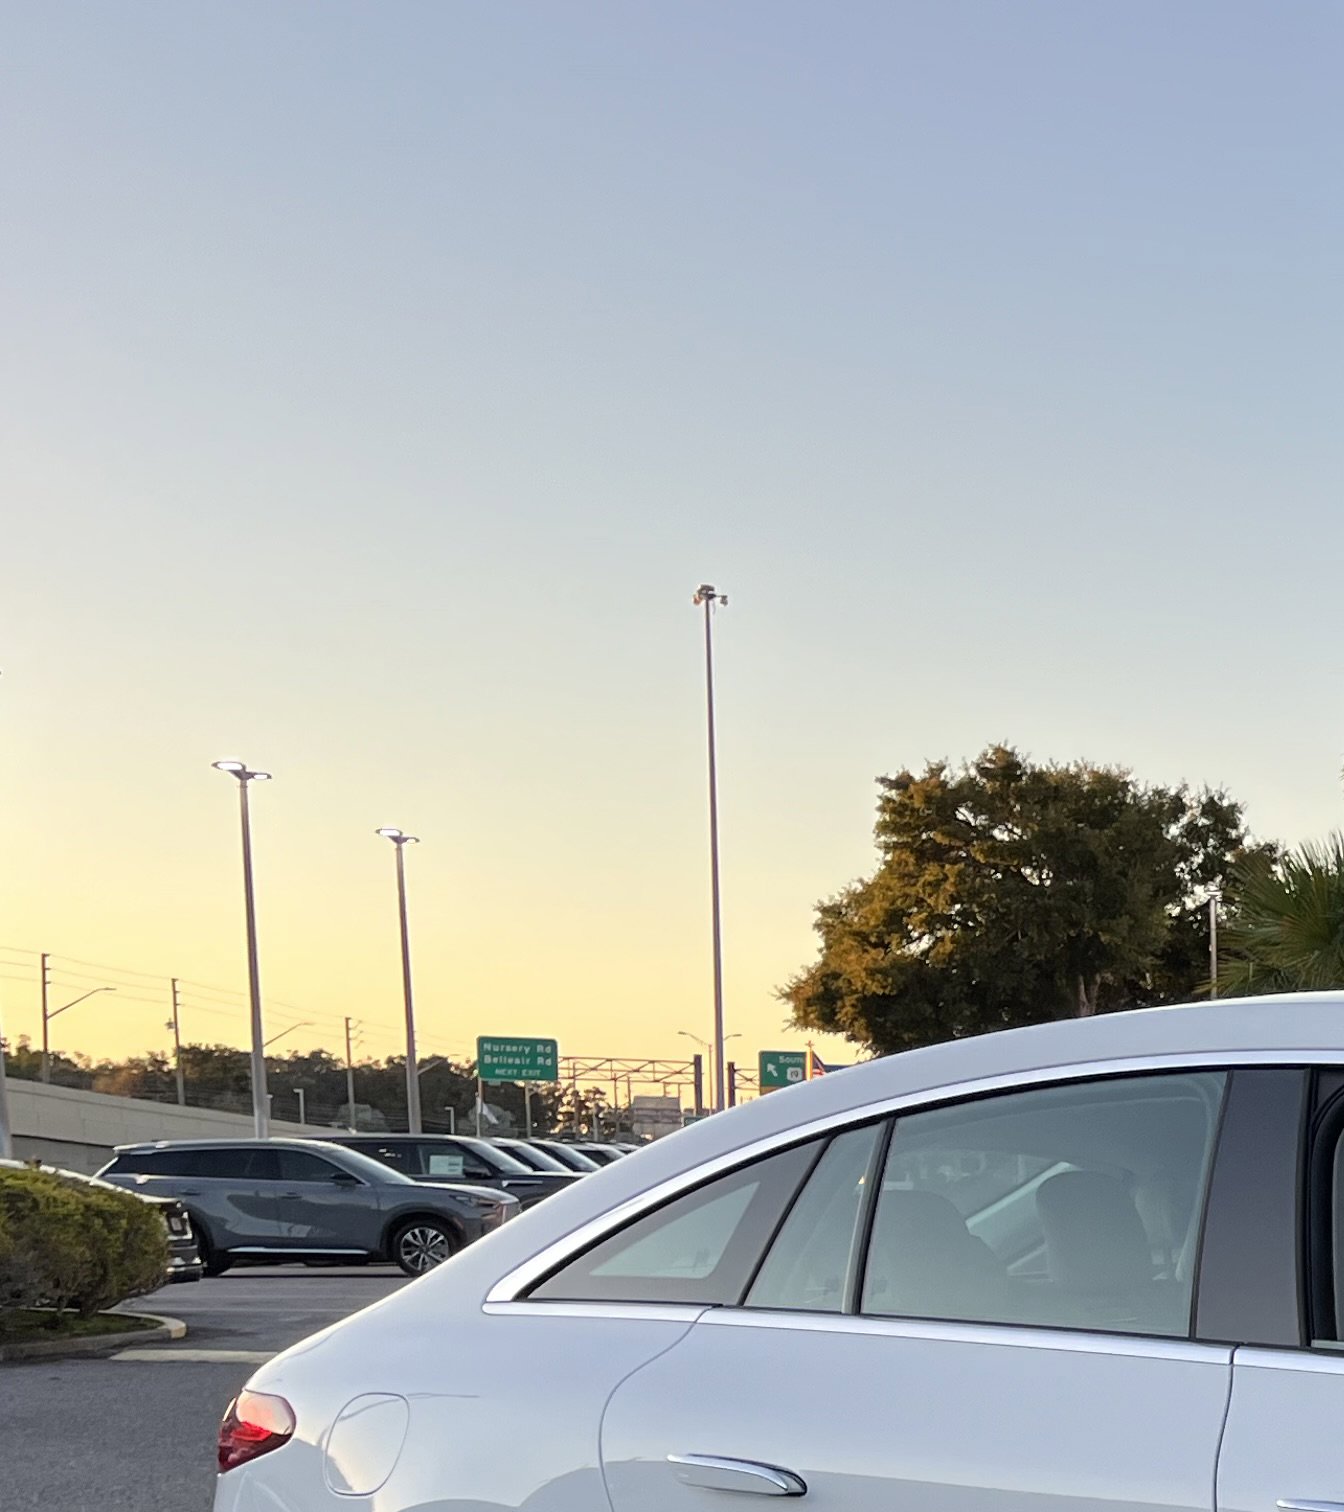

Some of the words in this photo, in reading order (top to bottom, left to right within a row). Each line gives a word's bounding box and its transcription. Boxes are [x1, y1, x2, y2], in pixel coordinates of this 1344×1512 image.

[483, 1042, 531, 1055] Nursery
[536, 1044, 552, 1054] Rd
[483, 1055, 531, 1065] Belleair
[536, 1056, 552, 1066] Rd
[495, 1068, 518, 1076] NEXT
[521, 1069, 541, 1077] EXIT
